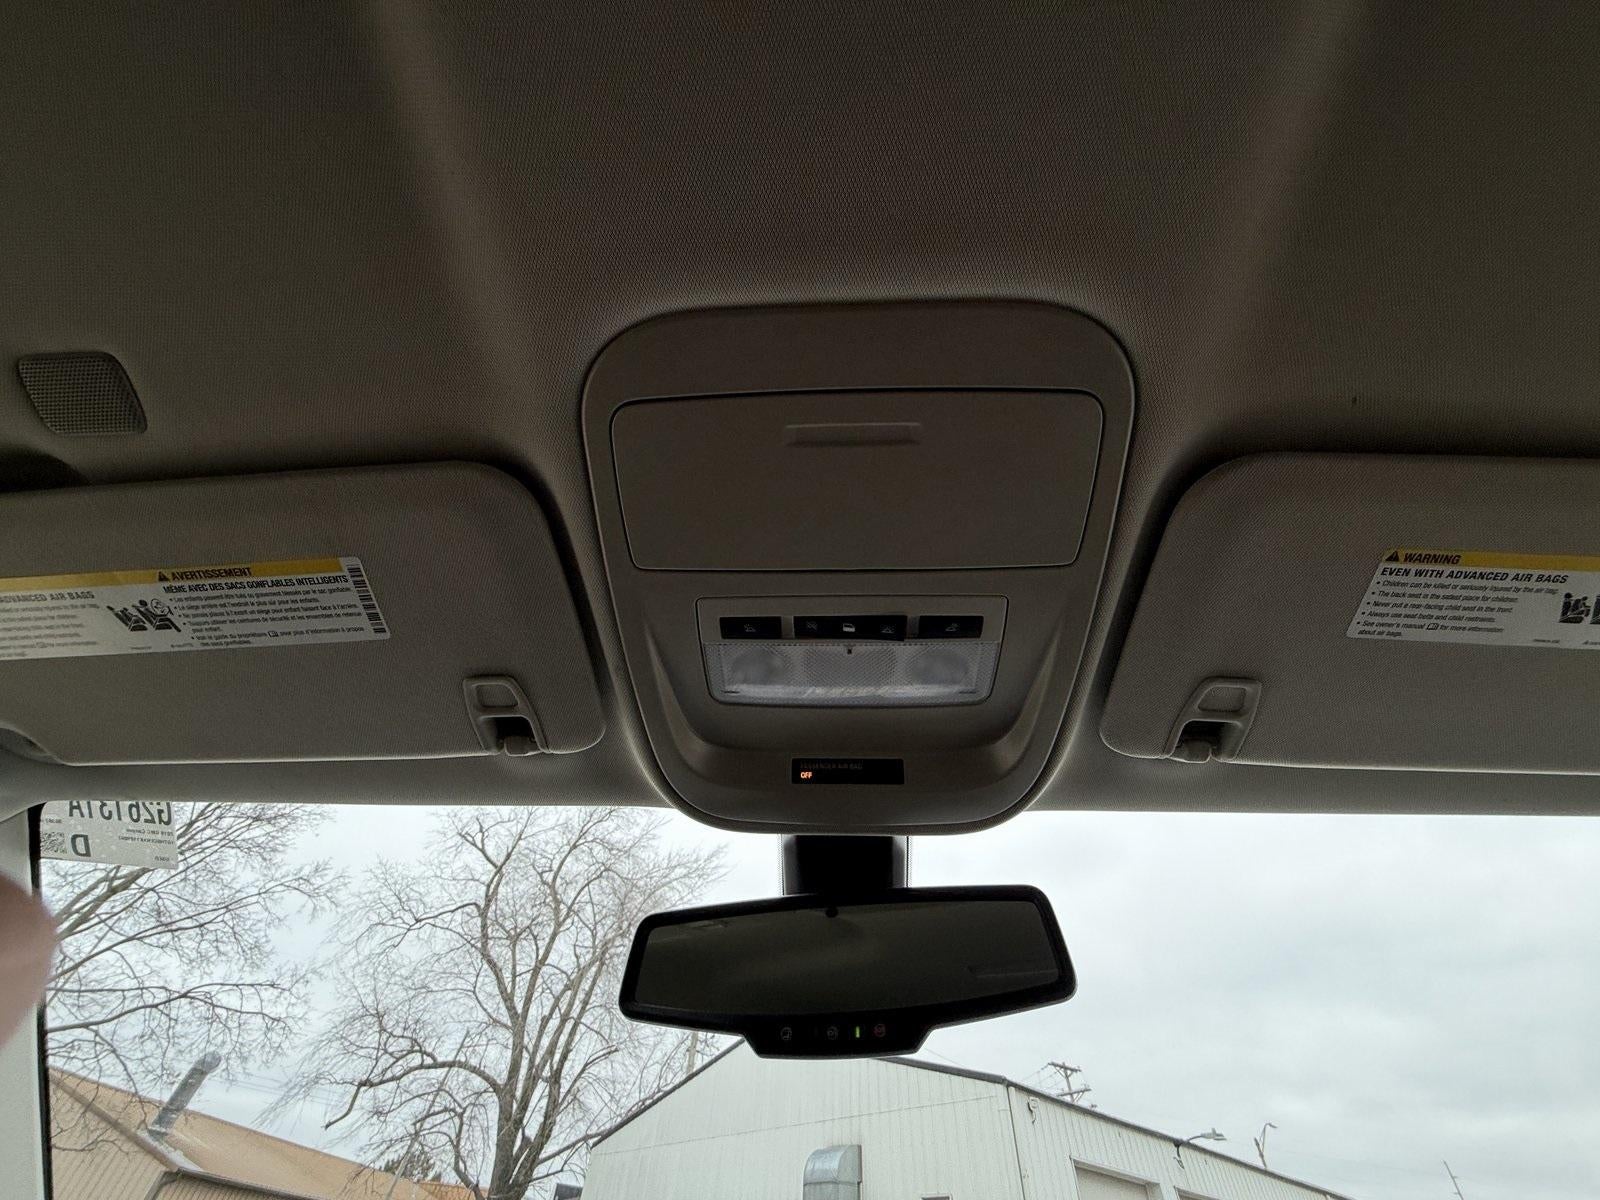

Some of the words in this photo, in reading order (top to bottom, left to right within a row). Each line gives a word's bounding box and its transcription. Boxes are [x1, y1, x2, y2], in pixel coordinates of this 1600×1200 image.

[1404, 553, 1461, 564] WARNING
[172, 567, 251, 580] AVERTISSEMENT
[1380, 567, 1411, 577] EVEN
[1414, 569, 1444, 578] WITH
[1445, 570, 1509, 581] ADVANCED
[1510, 573, 1533, 582] AIR
[1535, 574, 1568, 584] BAGS
[188, 583, 208, 593] AVEC
[208, 581, 225, 592] DES
[226, 581, 247, 591] SACS
[247, 579, 296, 590] GONFLABLES
[296, 575, 349, 587] INTELLIGENTS
[50, 592, 68, 601] AIR
[68, 591, 95, 600] BAGS
[800, 772, 813, 780] OFF
